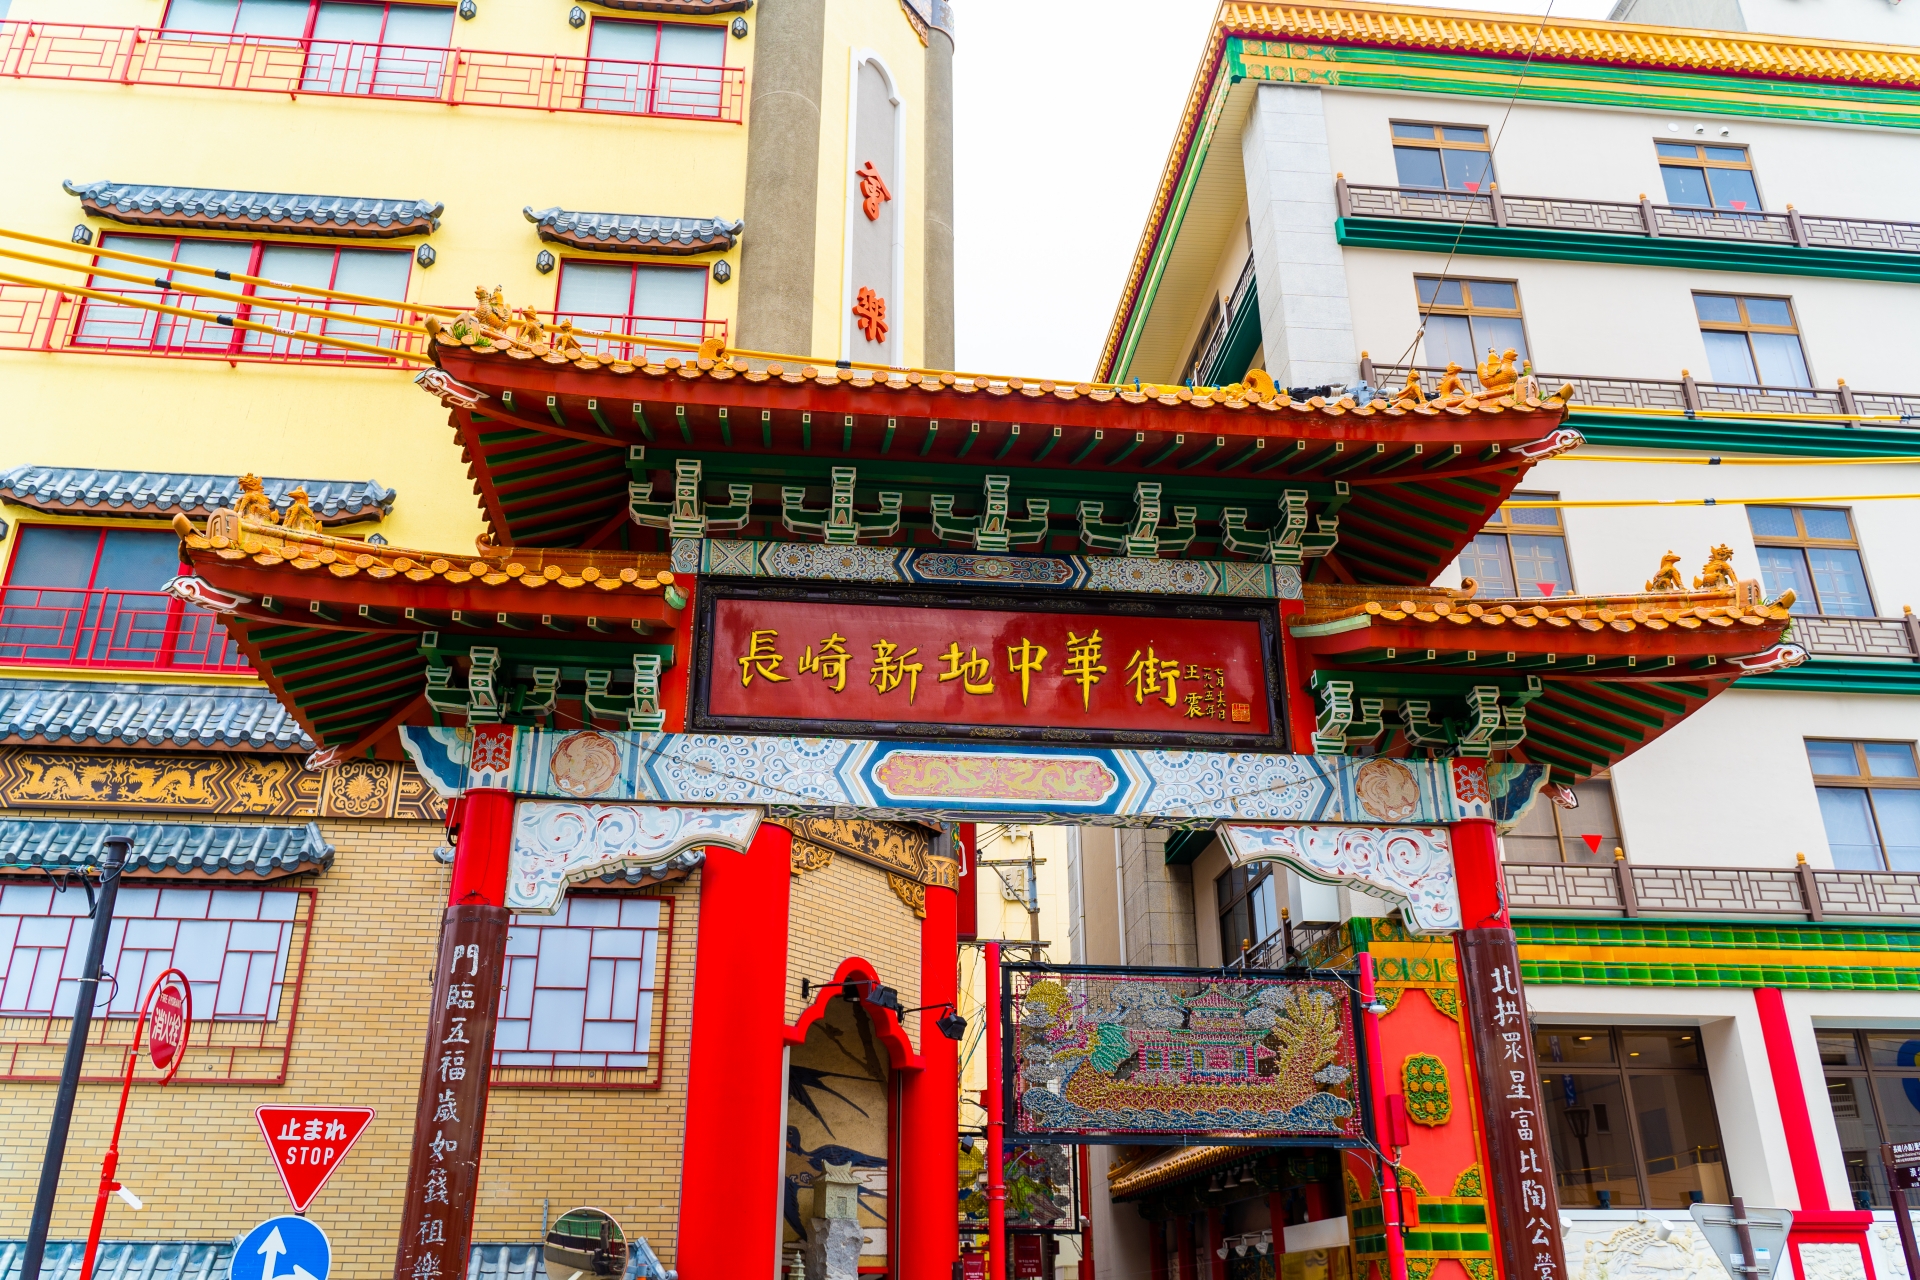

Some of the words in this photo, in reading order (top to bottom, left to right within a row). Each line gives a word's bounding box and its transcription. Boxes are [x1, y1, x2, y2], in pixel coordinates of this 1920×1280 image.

[737, 629, 1179, 714] 長崎新地中華街
[1183, 664, 1206, 718] 王震
[1202, 667, 1216, 719] 一九八五年
[151, 1006, 181, 1047] 消火栓
[276, 1117, 347, 1141] 止まれ
[286, 1146, 335, 1165] STOP
